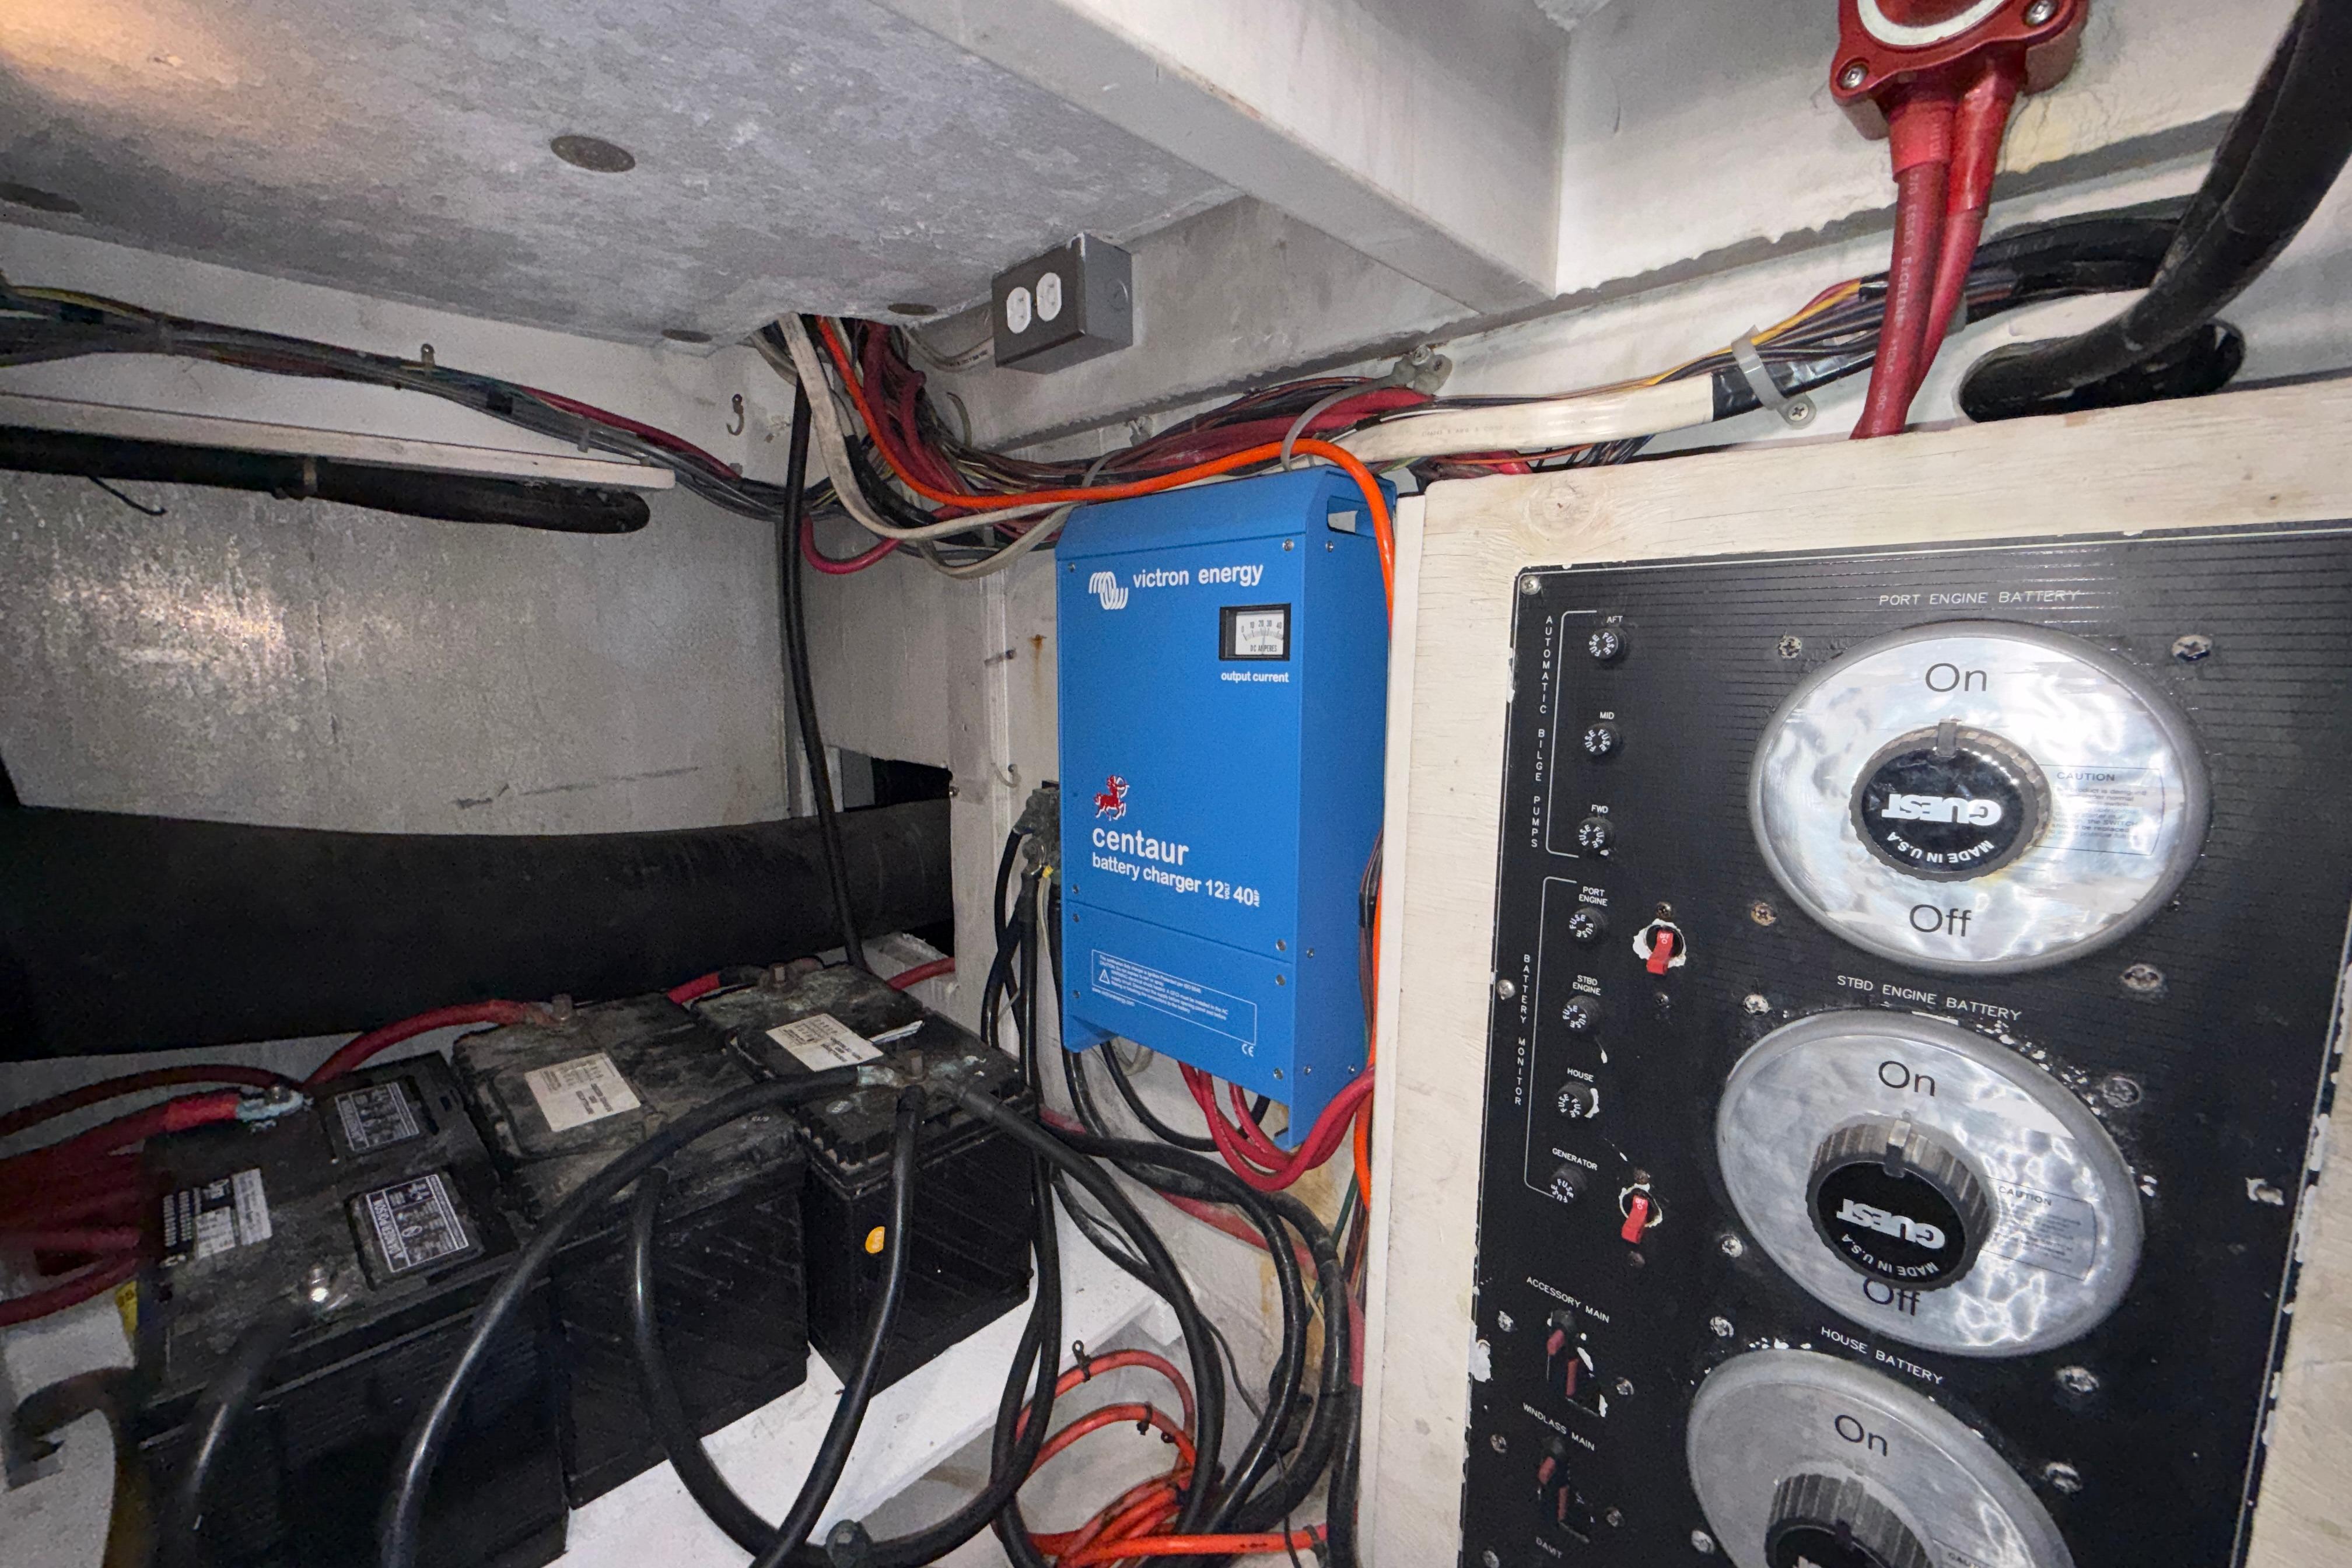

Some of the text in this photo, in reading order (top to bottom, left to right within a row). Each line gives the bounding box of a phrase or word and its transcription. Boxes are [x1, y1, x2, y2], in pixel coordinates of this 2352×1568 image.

[1133, 564, 1264, 588] victron energy
[1879, 589, 2081, 607] PORT ENGINE BATTERY
[1606, 615, 1623, 624] AFT
[1589, 634, 1601, 657] FUSE
[1602, 632, 1615, 655] FUSE
[1221, 671, 1289, 684] output current
[1925, 662, 1988, 692] On
[1600, 712, 1615, 720] MID
[1531, 616, 1553, 848] AUTOMATIC BILGE PUMPS
[1584, 729, 1596, 752] FUSE
[1598, 729, 1610, 752] FUSE
[2056, 772, 2115, 782] CAUTION
[1591, 804, 1609, 814] FWD
[1881, 793, 2002, 826] GUEST
[1092, 827, 1189, 865] centaur
[1578, 824, 1591, 846] FUSE
[1591, 826, 1604, 849] FUSE
[1926, 853, 1943, 863] IN
[1947, 840, 1995, 863] MADE
[1092, 852, 1140, 881] battery
[1143, 865, 1202, 893] charger
[1578, 894, 1608, 907] ENGINE
[1583, 886, 1605, 897] PORT
[1569, 914, 1586, 929] FUSE
[1576, 923, 1594, 938] FUSE
[1909, 904, 1972, 937] Off
[1572, 982, 1601, 996] ENGINE
[1577, 975, 1598, 986] STBD
[1837, 975, 2022, 1021] STBD ENGINE BATTERY
[1562, 1005, 1578, 1020] FUSE
[1570, 1013, 1587, 1028] FUSE
[1514, 955, 1531, 1105] BATTERY MONITOR
[1567, 1067, 1594, 1083] HOUSE
[1878, 1060, 1936, 1097] On
[1552, 1147, 1598, 1171] GENERATOR
[1550, 1184, 1568, 1203] FUSE
[1557, 1178, 1574, 1198] FUSE
[1999, 1185, 2052, 1206] CAUTION
[1836, 1198, 1945, 1249] GUEST
[1877, 1260, 1892, 1273] IN
[1897, 1261, 1940, 1277] MADE
[1527, 1276, 1610, 1324] ACCESSORY MAIN
[1863, 1278, 1921, 1316] Off
[1821, 1326, 1944, 1385] HOUSE BATTERY
[1523, 1402, 1595, 1451] WINDLASS MAIN
[1835, 1415, 1888, 1457] On
